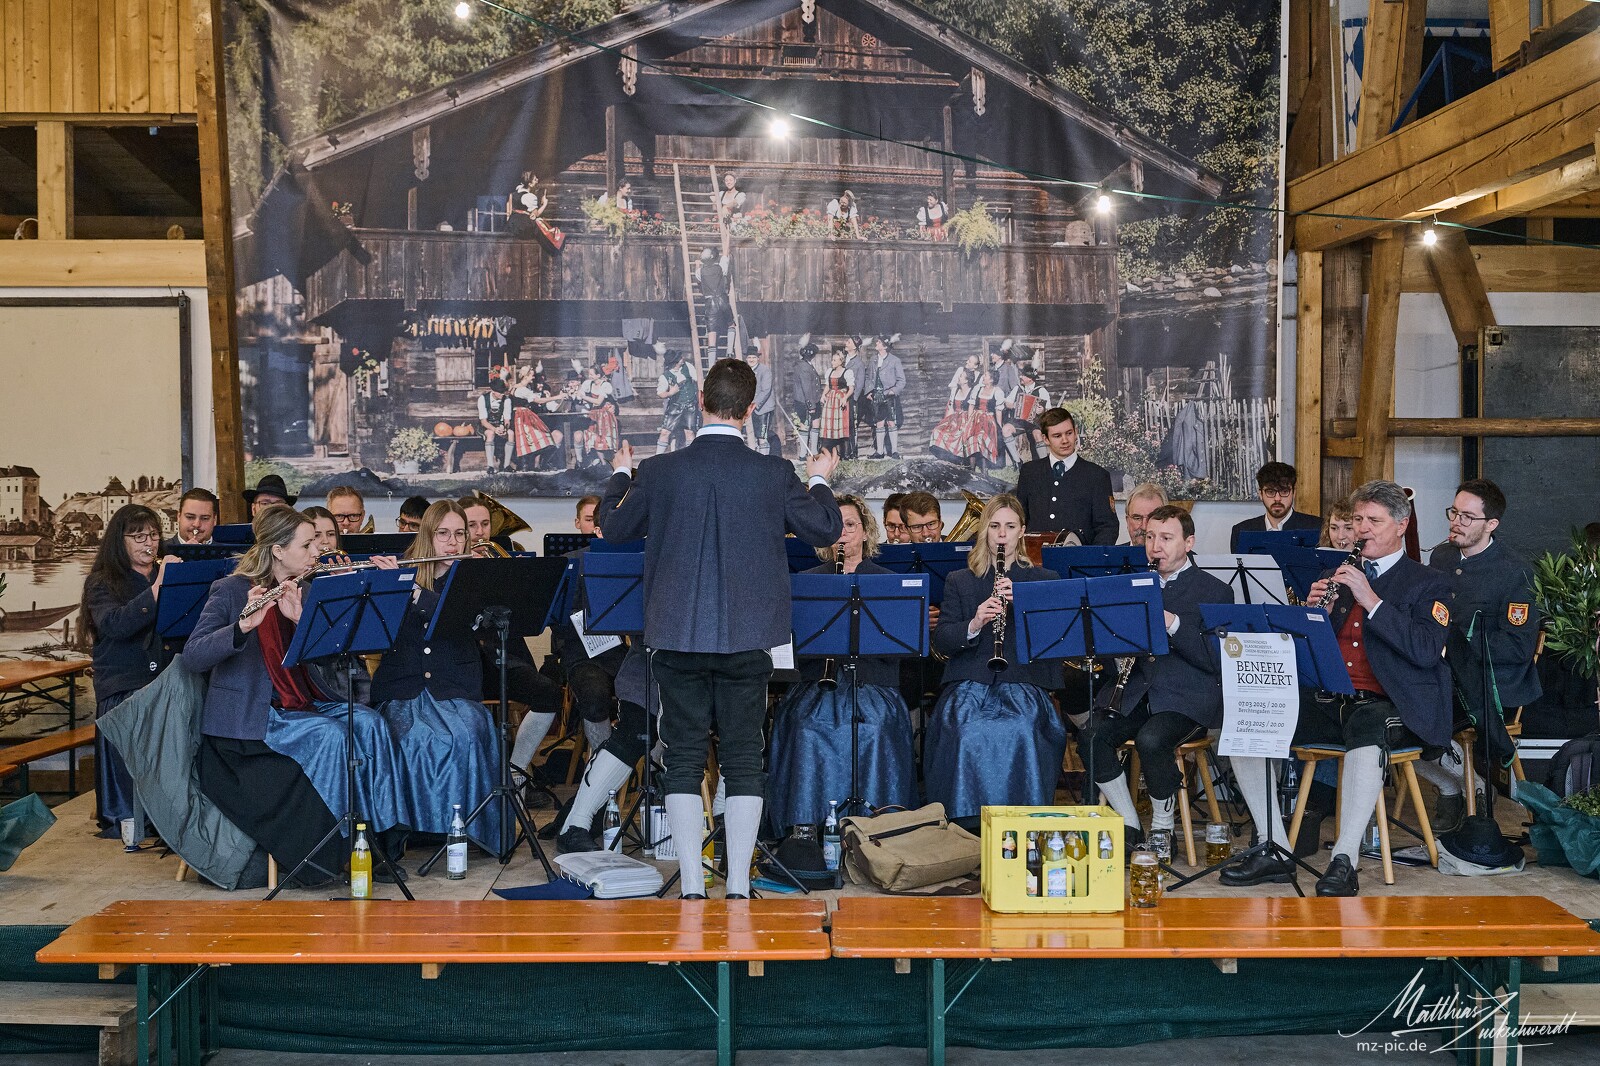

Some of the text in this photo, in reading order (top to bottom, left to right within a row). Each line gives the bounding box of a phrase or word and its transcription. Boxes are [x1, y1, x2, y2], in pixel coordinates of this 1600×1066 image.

[1229, 643, 1239, 652] 10
[1236, 660, 1285, 674] BENEFIZ
[1237, 673, 1293, 686] KONZERT
